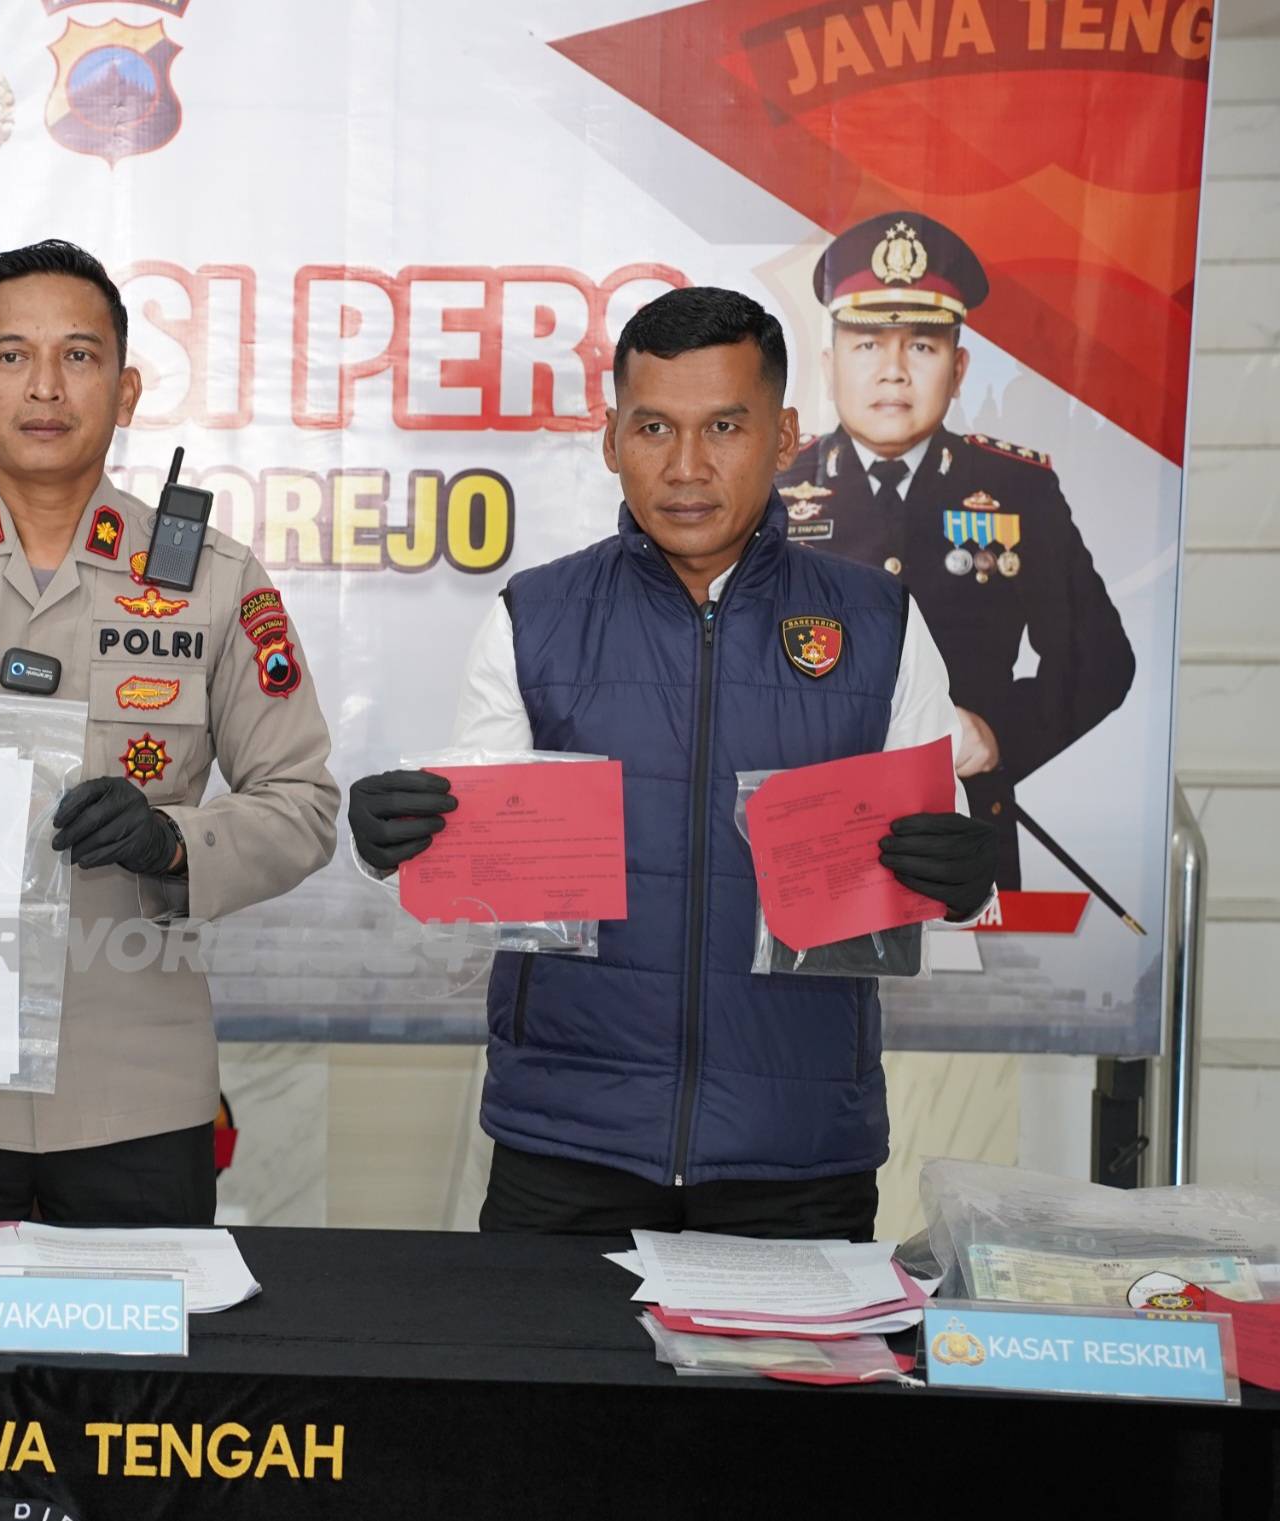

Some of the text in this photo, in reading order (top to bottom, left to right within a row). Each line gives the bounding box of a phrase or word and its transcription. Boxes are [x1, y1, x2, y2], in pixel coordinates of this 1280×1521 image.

[785, 0, 996, 96] JAWA
[242, 592, 277, 614] POLRES
[786, 619, 837, 630] BARESKRIM
[99, 628, 204, 659] POLRI
[988, 1335, 1208, 1369] KASAT RESKRIM
[85, 1422, 345, 1480] TENGAH
